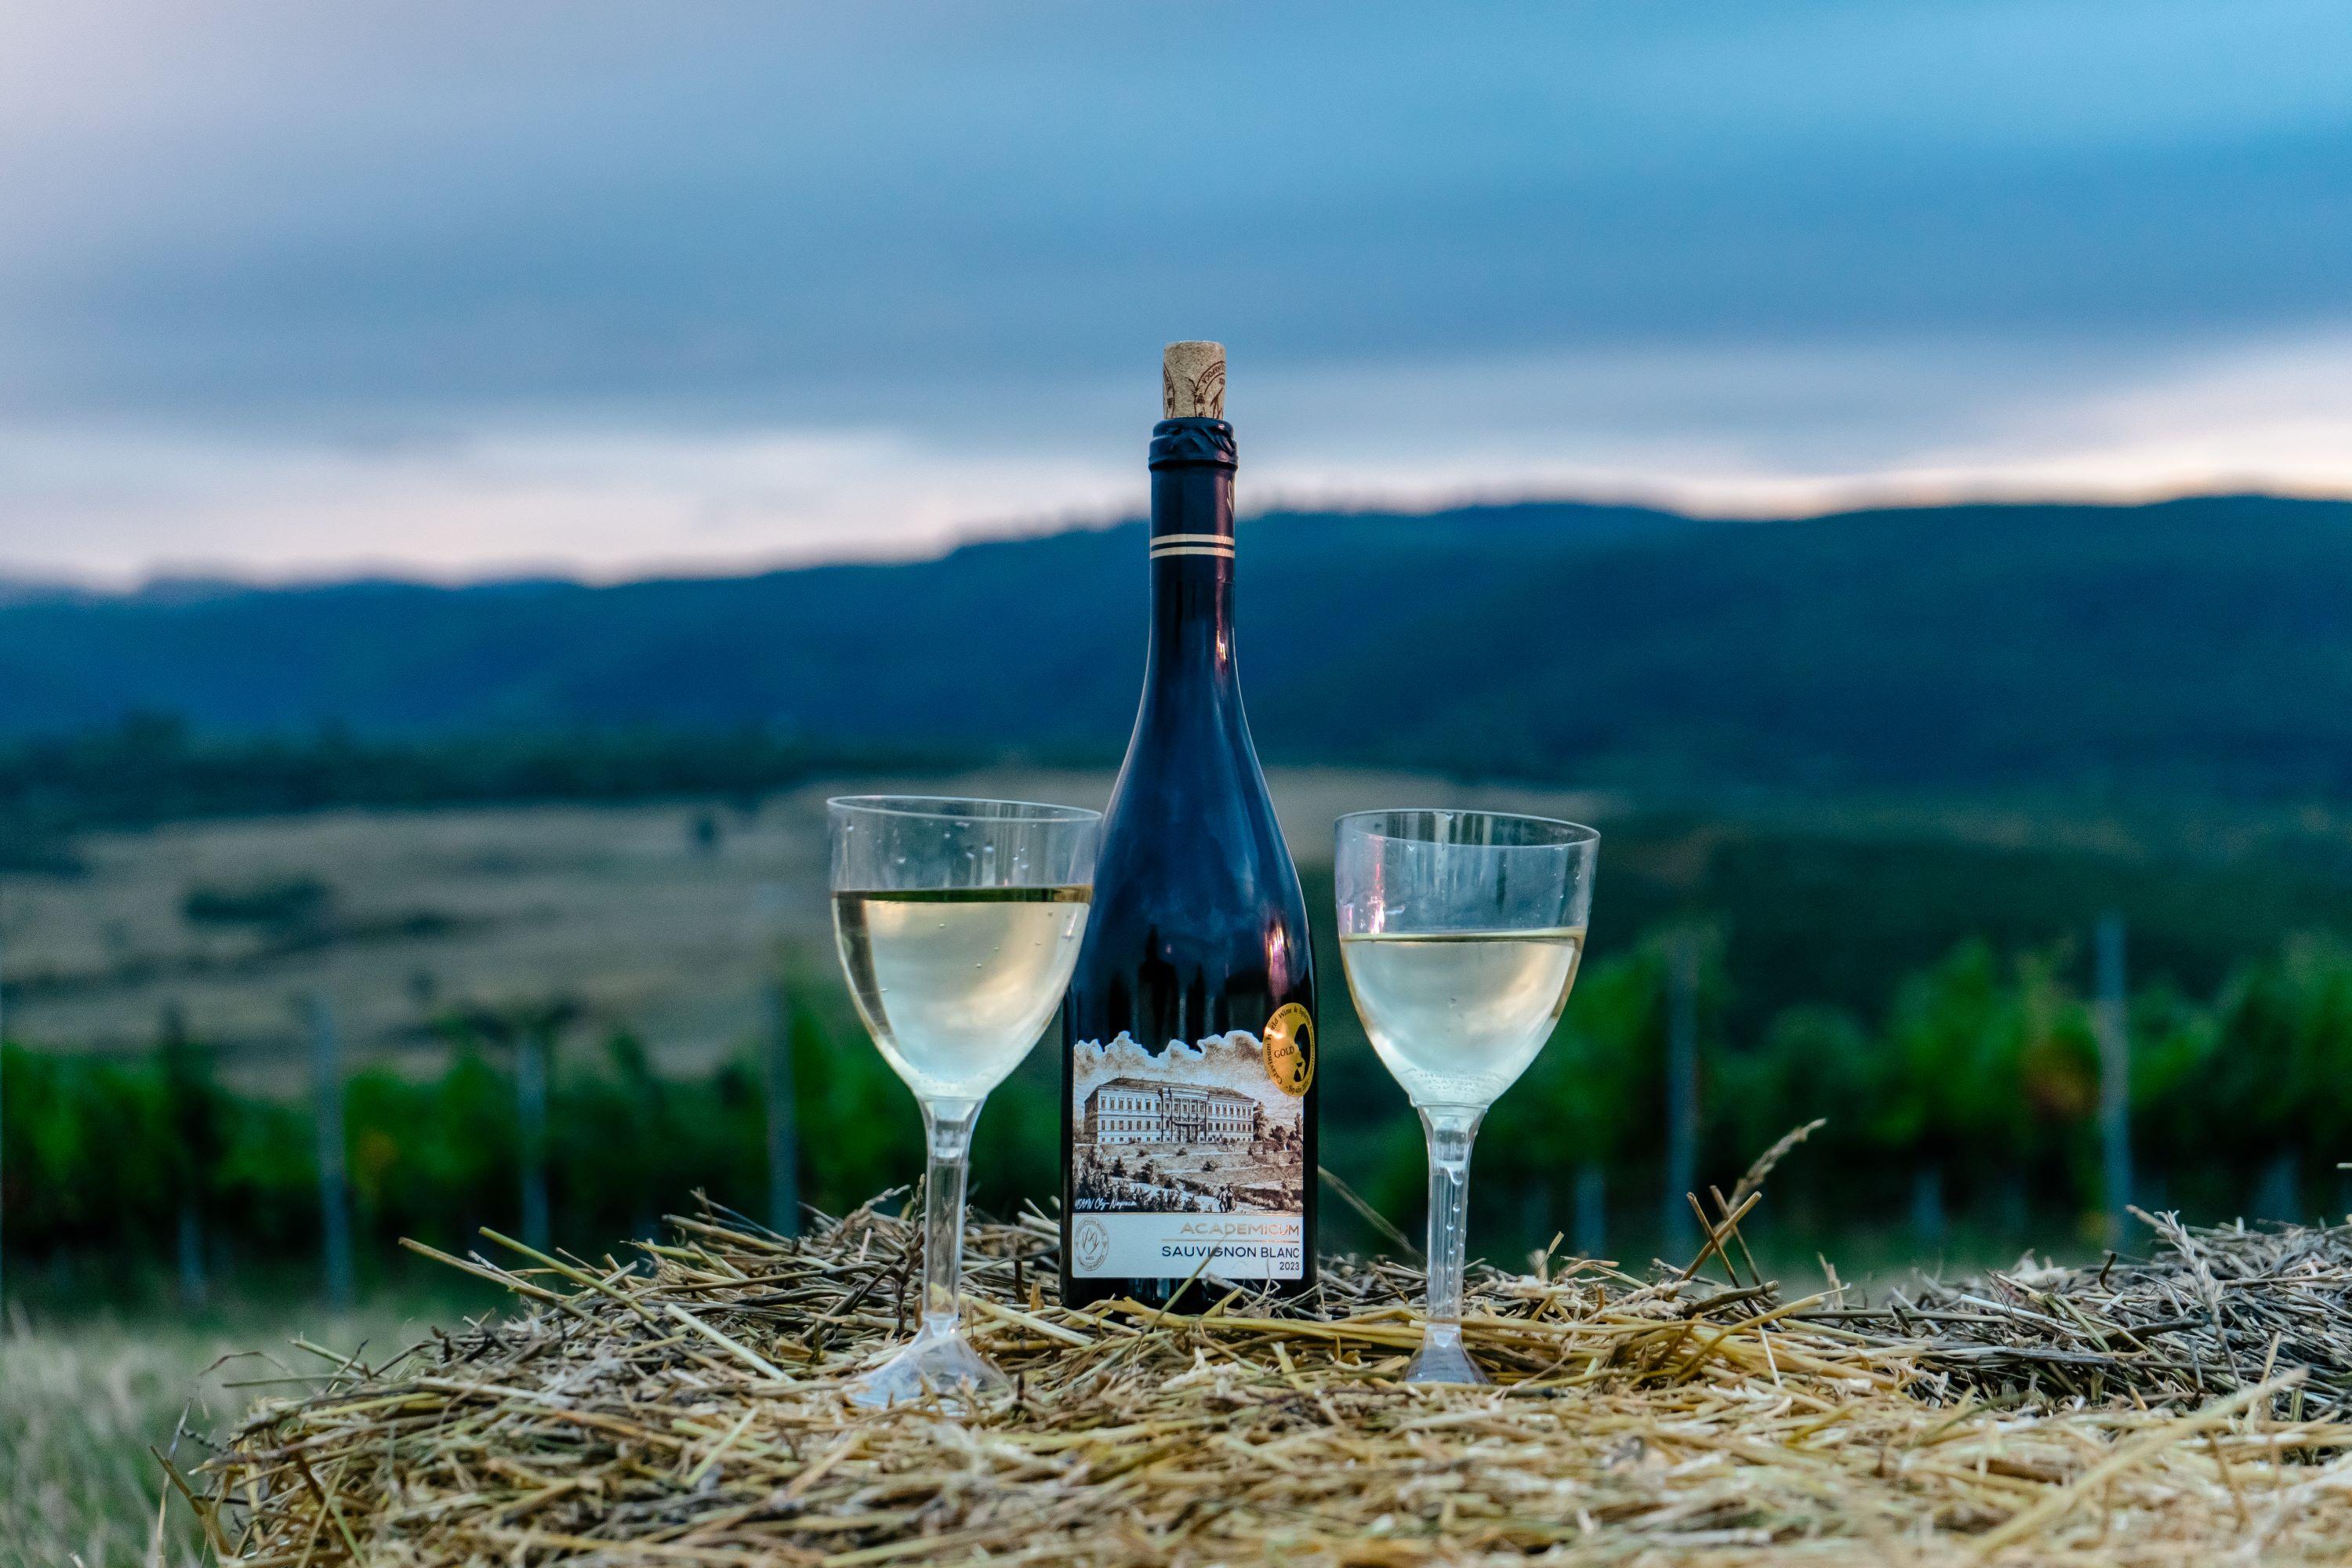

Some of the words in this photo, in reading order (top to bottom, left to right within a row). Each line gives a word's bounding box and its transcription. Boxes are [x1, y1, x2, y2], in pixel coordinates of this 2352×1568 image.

[1274, 1046, 1294, 1058] GOLD
[1180, 1222, 1299, 1236] ACADEMICUM
[1161, 1245, 1257, 1258] SAUVIGNON
[1261, 1247, 1299, 1258] BLANC
[1279, 1261, 1299, 1271] 2023
